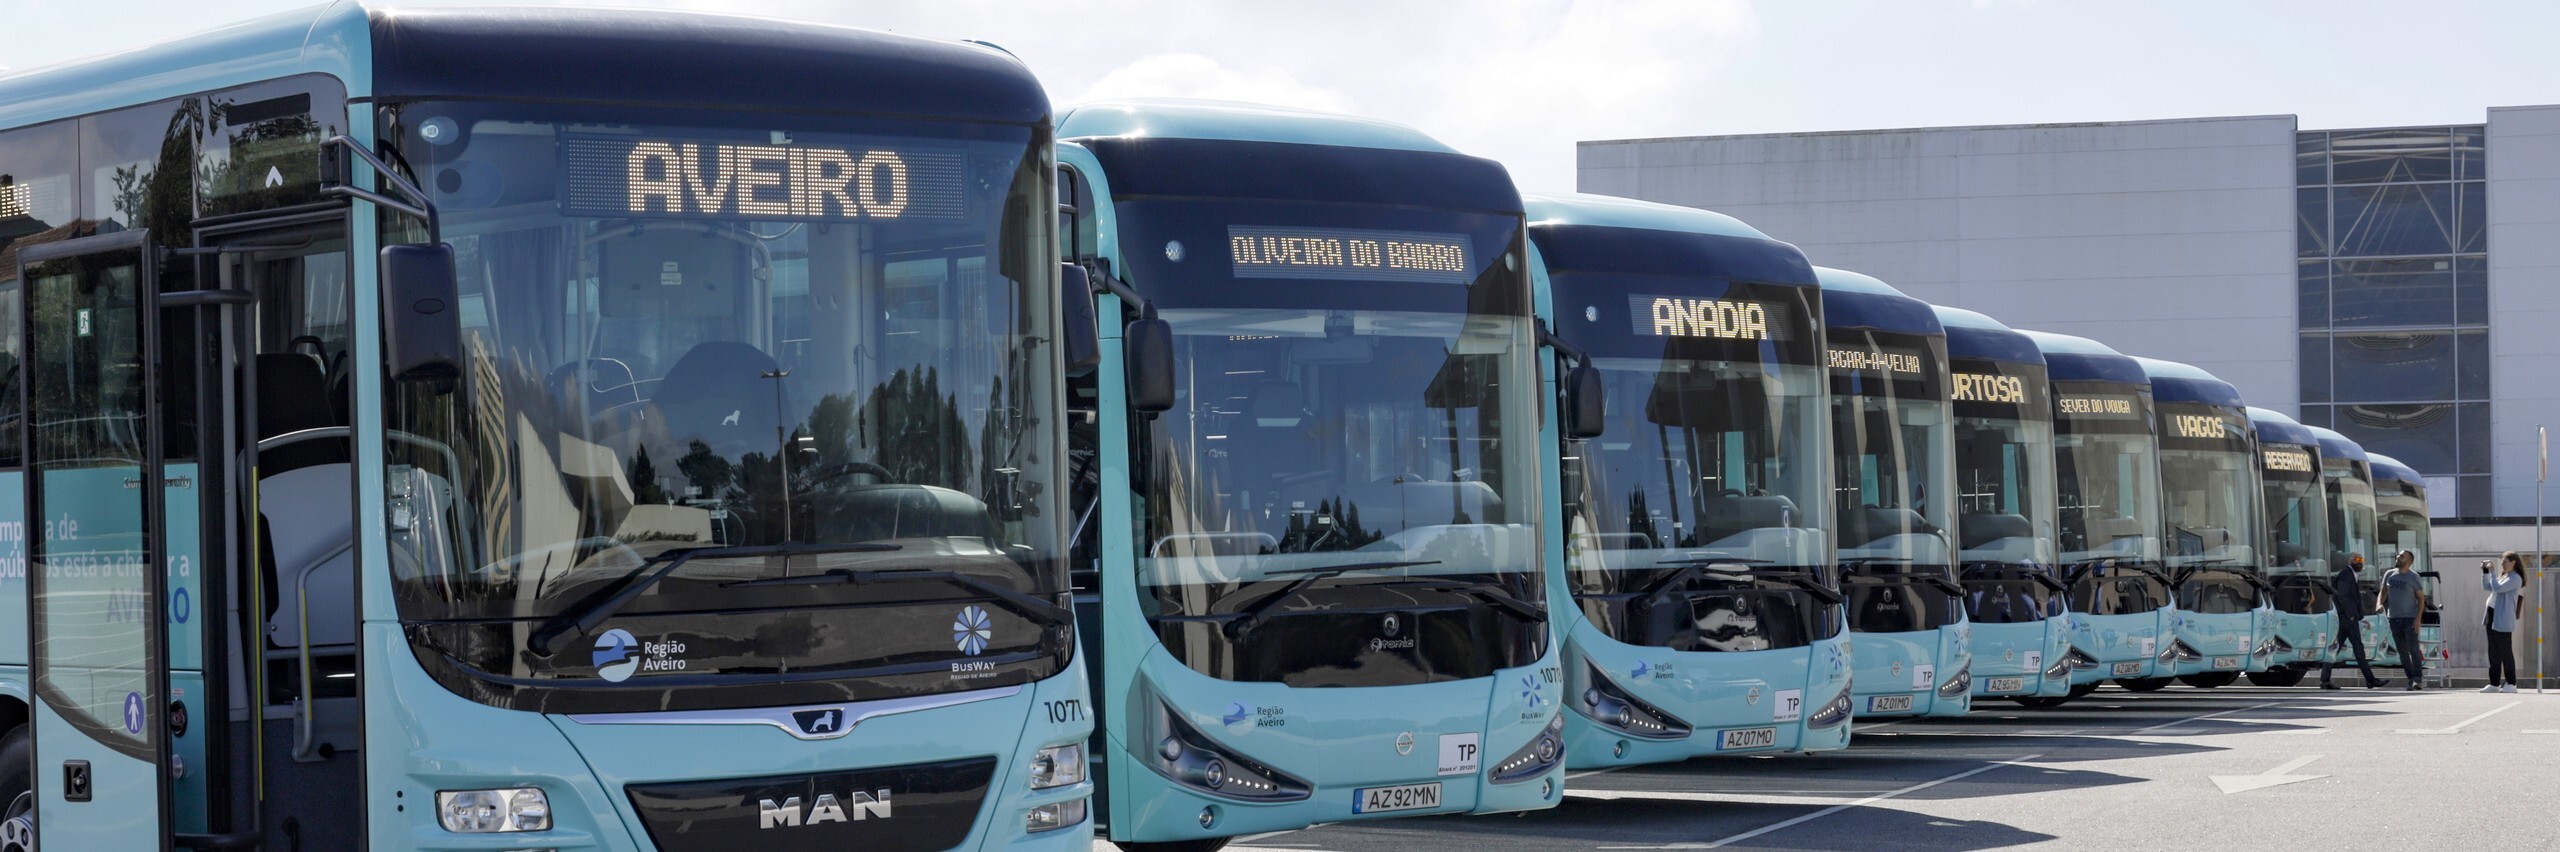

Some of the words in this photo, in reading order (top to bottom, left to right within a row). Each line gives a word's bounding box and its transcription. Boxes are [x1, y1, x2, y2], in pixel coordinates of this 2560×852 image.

[627, 141, 909, 219] AVEIRO
[0, 183, 31, 217] IRO
[1232, 236, 1343, 266] OLIVEIRA
[1349, 239, 1381, 267] DO
[1387, 241, 1464, 272] BAIRRO
[1652, 297, 1768, 340] ANADIA
[2060, 398, 2091, 413] SEVER
[2091, 399, 2104, 413] DO
[2104, 400, 2131, 414] VOUGA
[2176, 415, 2225, 438] VAGOS
[2265, 451, 2311, 472] RESERVADO
[58, 512, 78, 540] de
[63, 549, 98, 578] está
[102, 557, 112, 578] a
[116, 548, 175, 578] cher
[179, 555, 190, 577] a
[644, 640, 686, 657] Região
[643, 657, 686, 671] Aveiro
[2032, 656, 2040, 666] TP
[1923, 671, 1933, 682] TP
[1044, 699, 1085, 724] 1071
[1257, 705, 1284, 718] Região
[1787, 698, 1800, 711] TP
[1876, 697, 1910, 710] AZ01MO
[1257, 717, 1285, 727] Aveiro
[1727, 729, 1773, 747] AZ07MO
[1458, 743, 1477, 761] TP
[1368, 785, 1437, 810] AZ92MN
[759, 788, 893, 829] MAN
